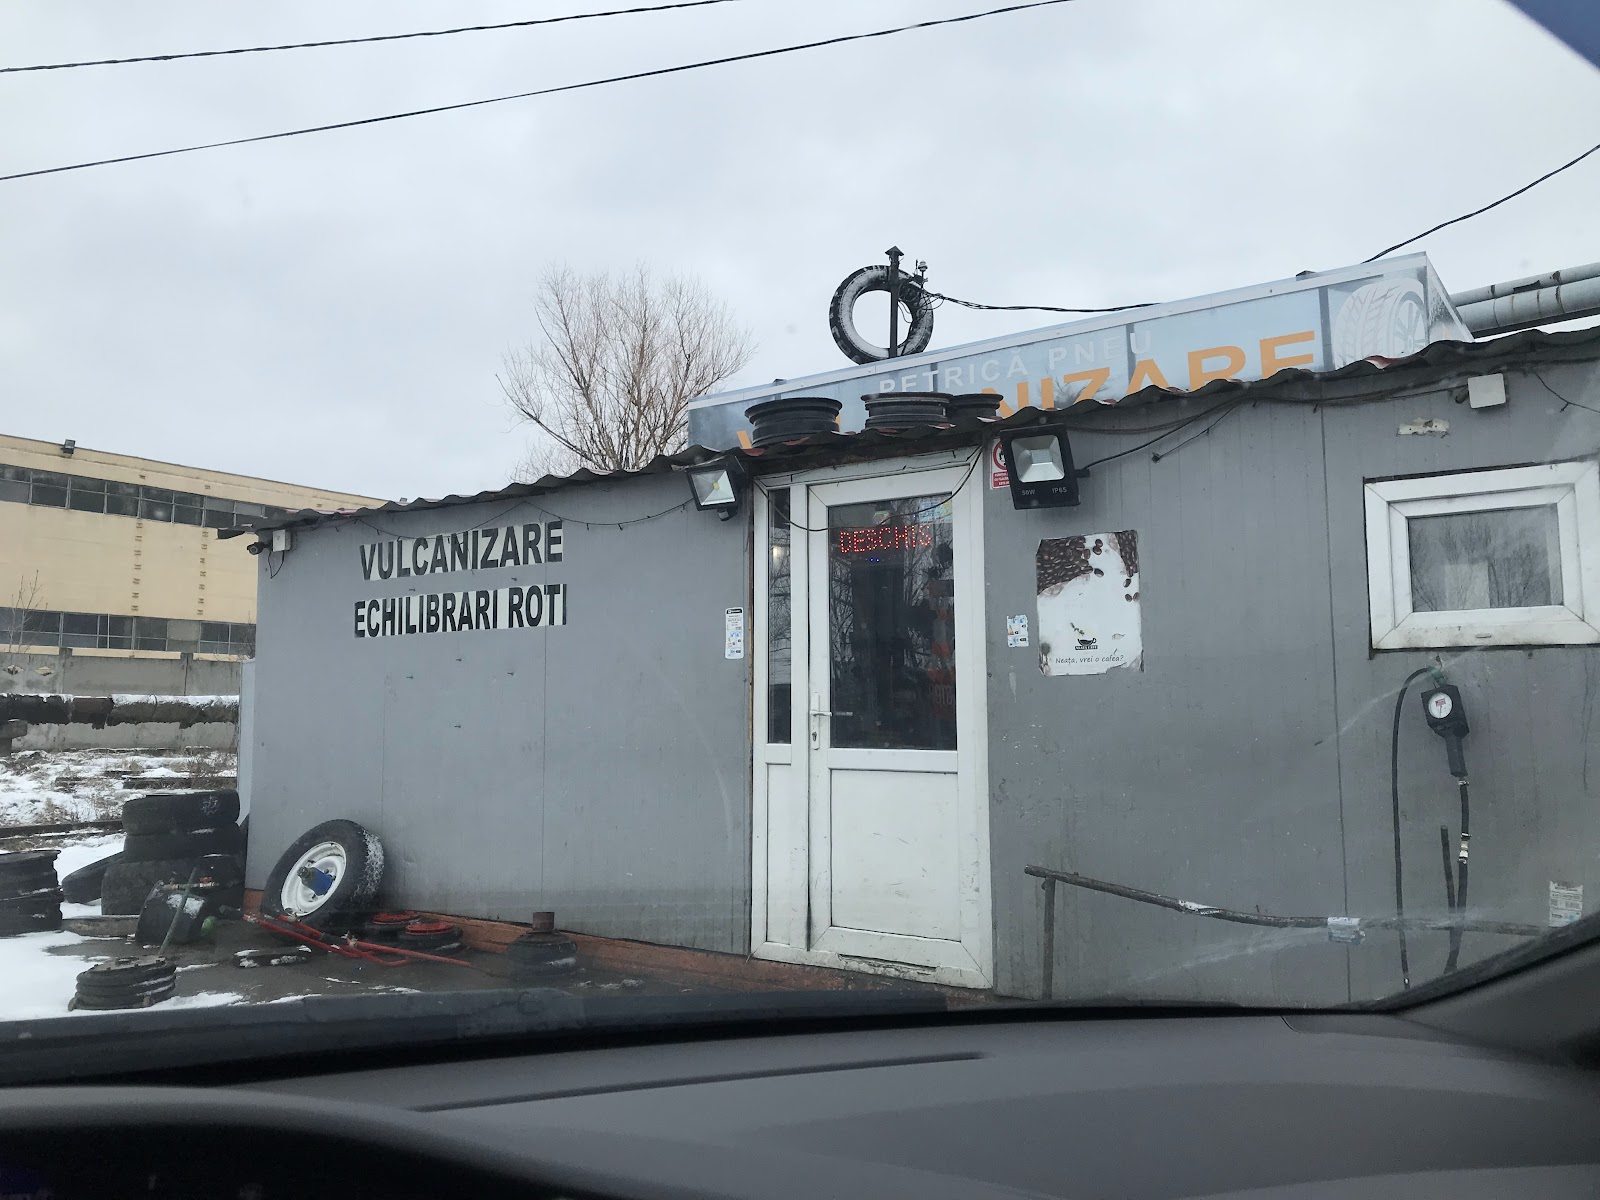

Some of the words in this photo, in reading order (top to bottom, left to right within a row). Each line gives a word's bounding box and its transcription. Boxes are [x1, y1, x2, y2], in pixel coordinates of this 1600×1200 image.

[1050, 329, 1151, 370] PNEU
[360, 520, 563, 580] VULCANIZARE
[840, 525, 932, 553] DESCHIS
[354, 589, 498, 638] ECHILIBRARI
[508, 583, 567, 629] ROTI
[1079, 655, 1094, 663] vrei
[1101, 654, 1124, 662] cafea?
